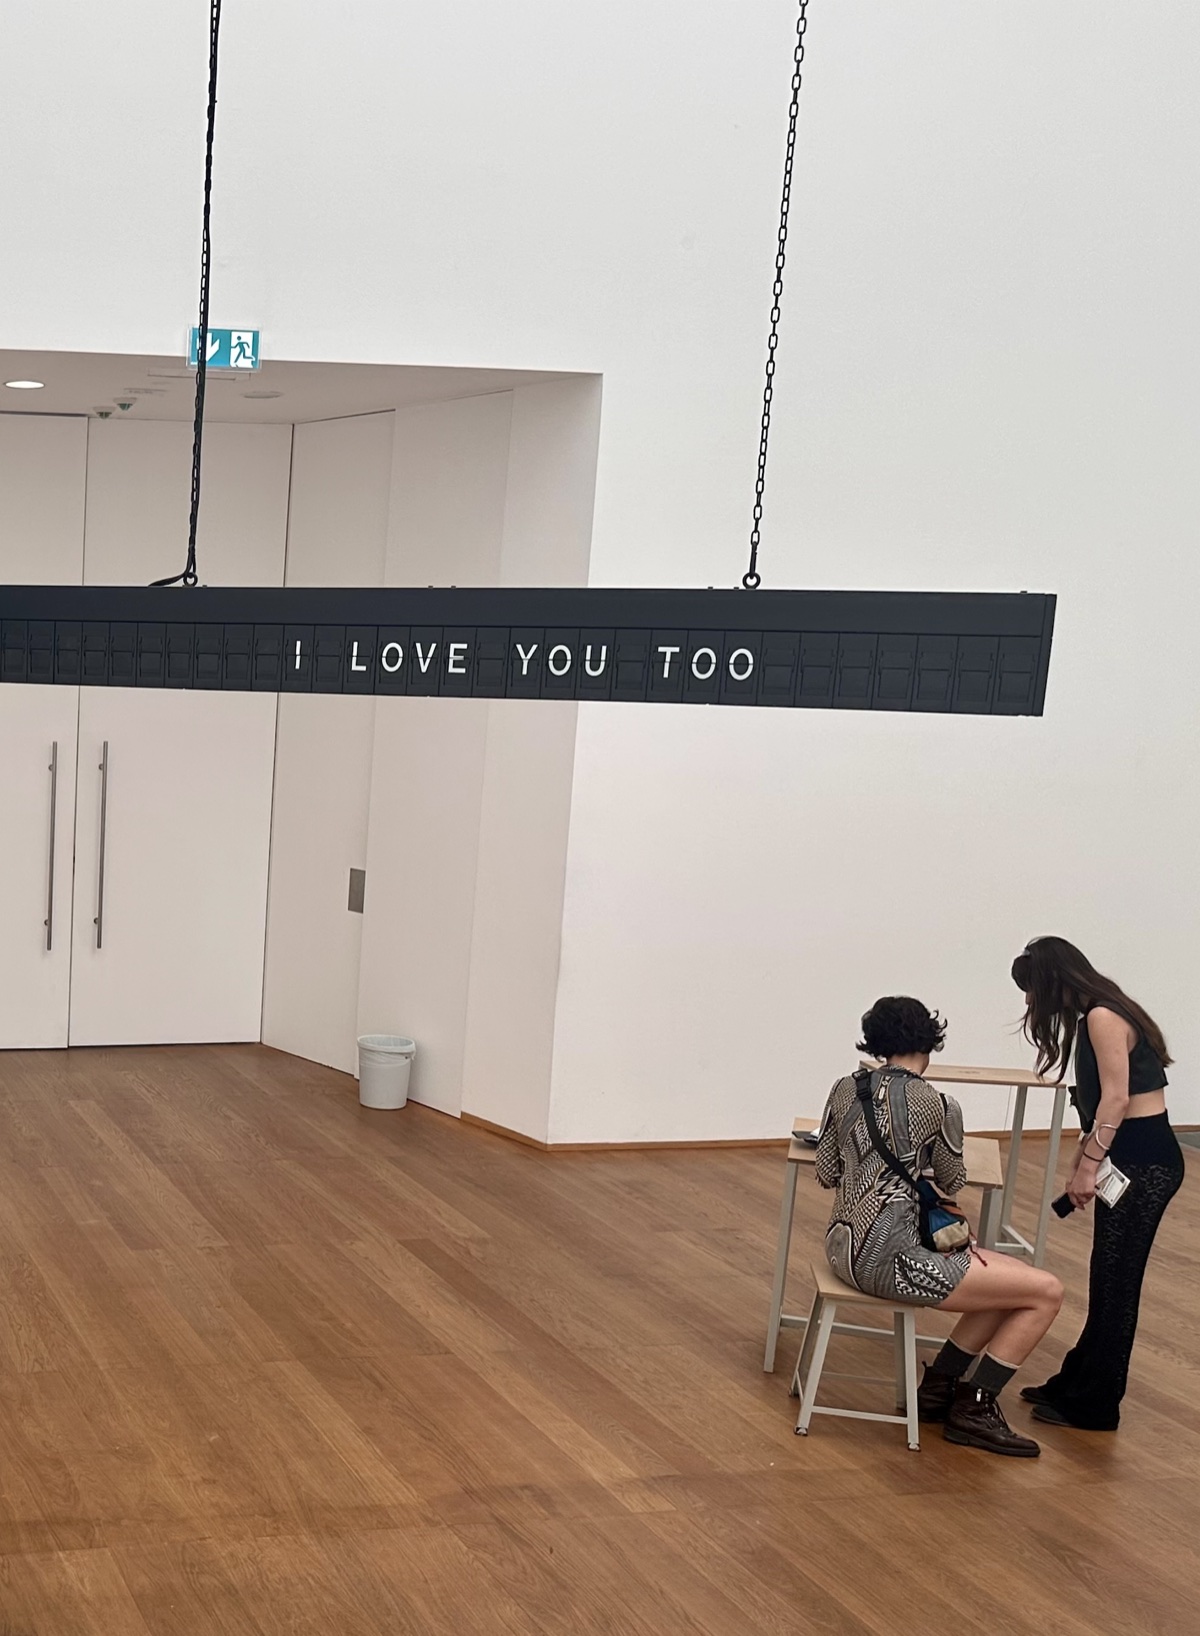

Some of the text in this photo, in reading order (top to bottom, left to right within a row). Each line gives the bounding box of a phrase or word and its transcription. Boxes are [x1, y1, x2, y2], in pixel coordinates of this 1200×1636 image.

[295, 640, 754, 681] I LOVE YOU TOO
